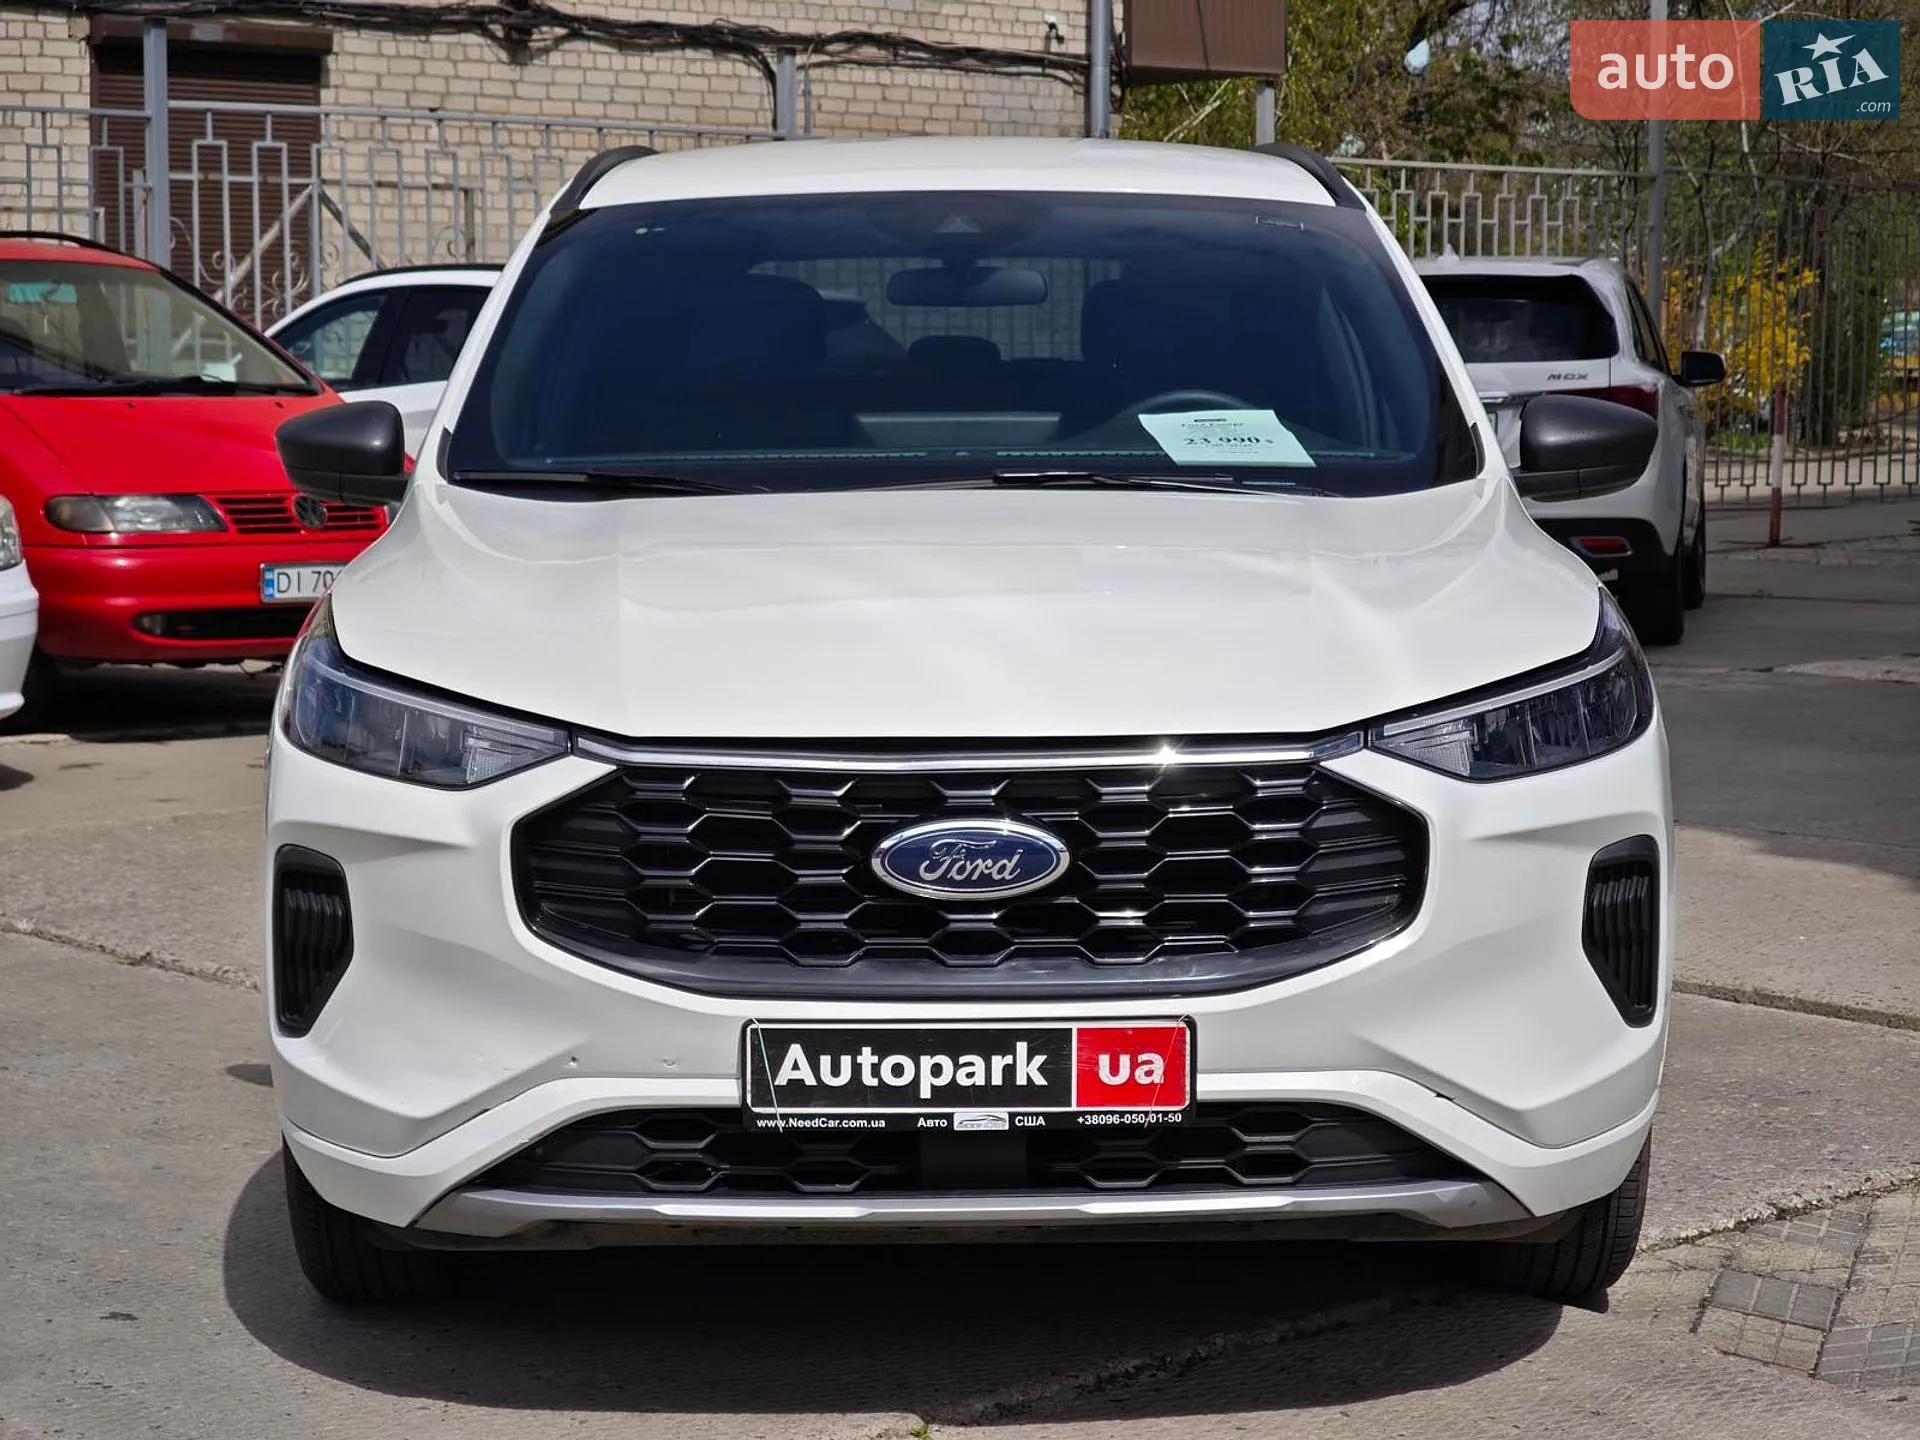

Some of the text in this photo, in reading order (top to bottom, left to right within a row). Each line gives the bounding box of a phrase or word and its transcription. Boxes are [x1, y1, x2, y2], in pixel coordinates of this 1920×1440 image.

[277, 569, 343, 594] DI 70
[919, 838, 1024, 881] Ford
[774, 1041, 1165, 1099] Autopark ua
[757, 1117, 886, 1128] www.NeedCar.com.ua
[917, 1117, 948, 1128] Авто
[1015, 1116, 1046, 1127] США
